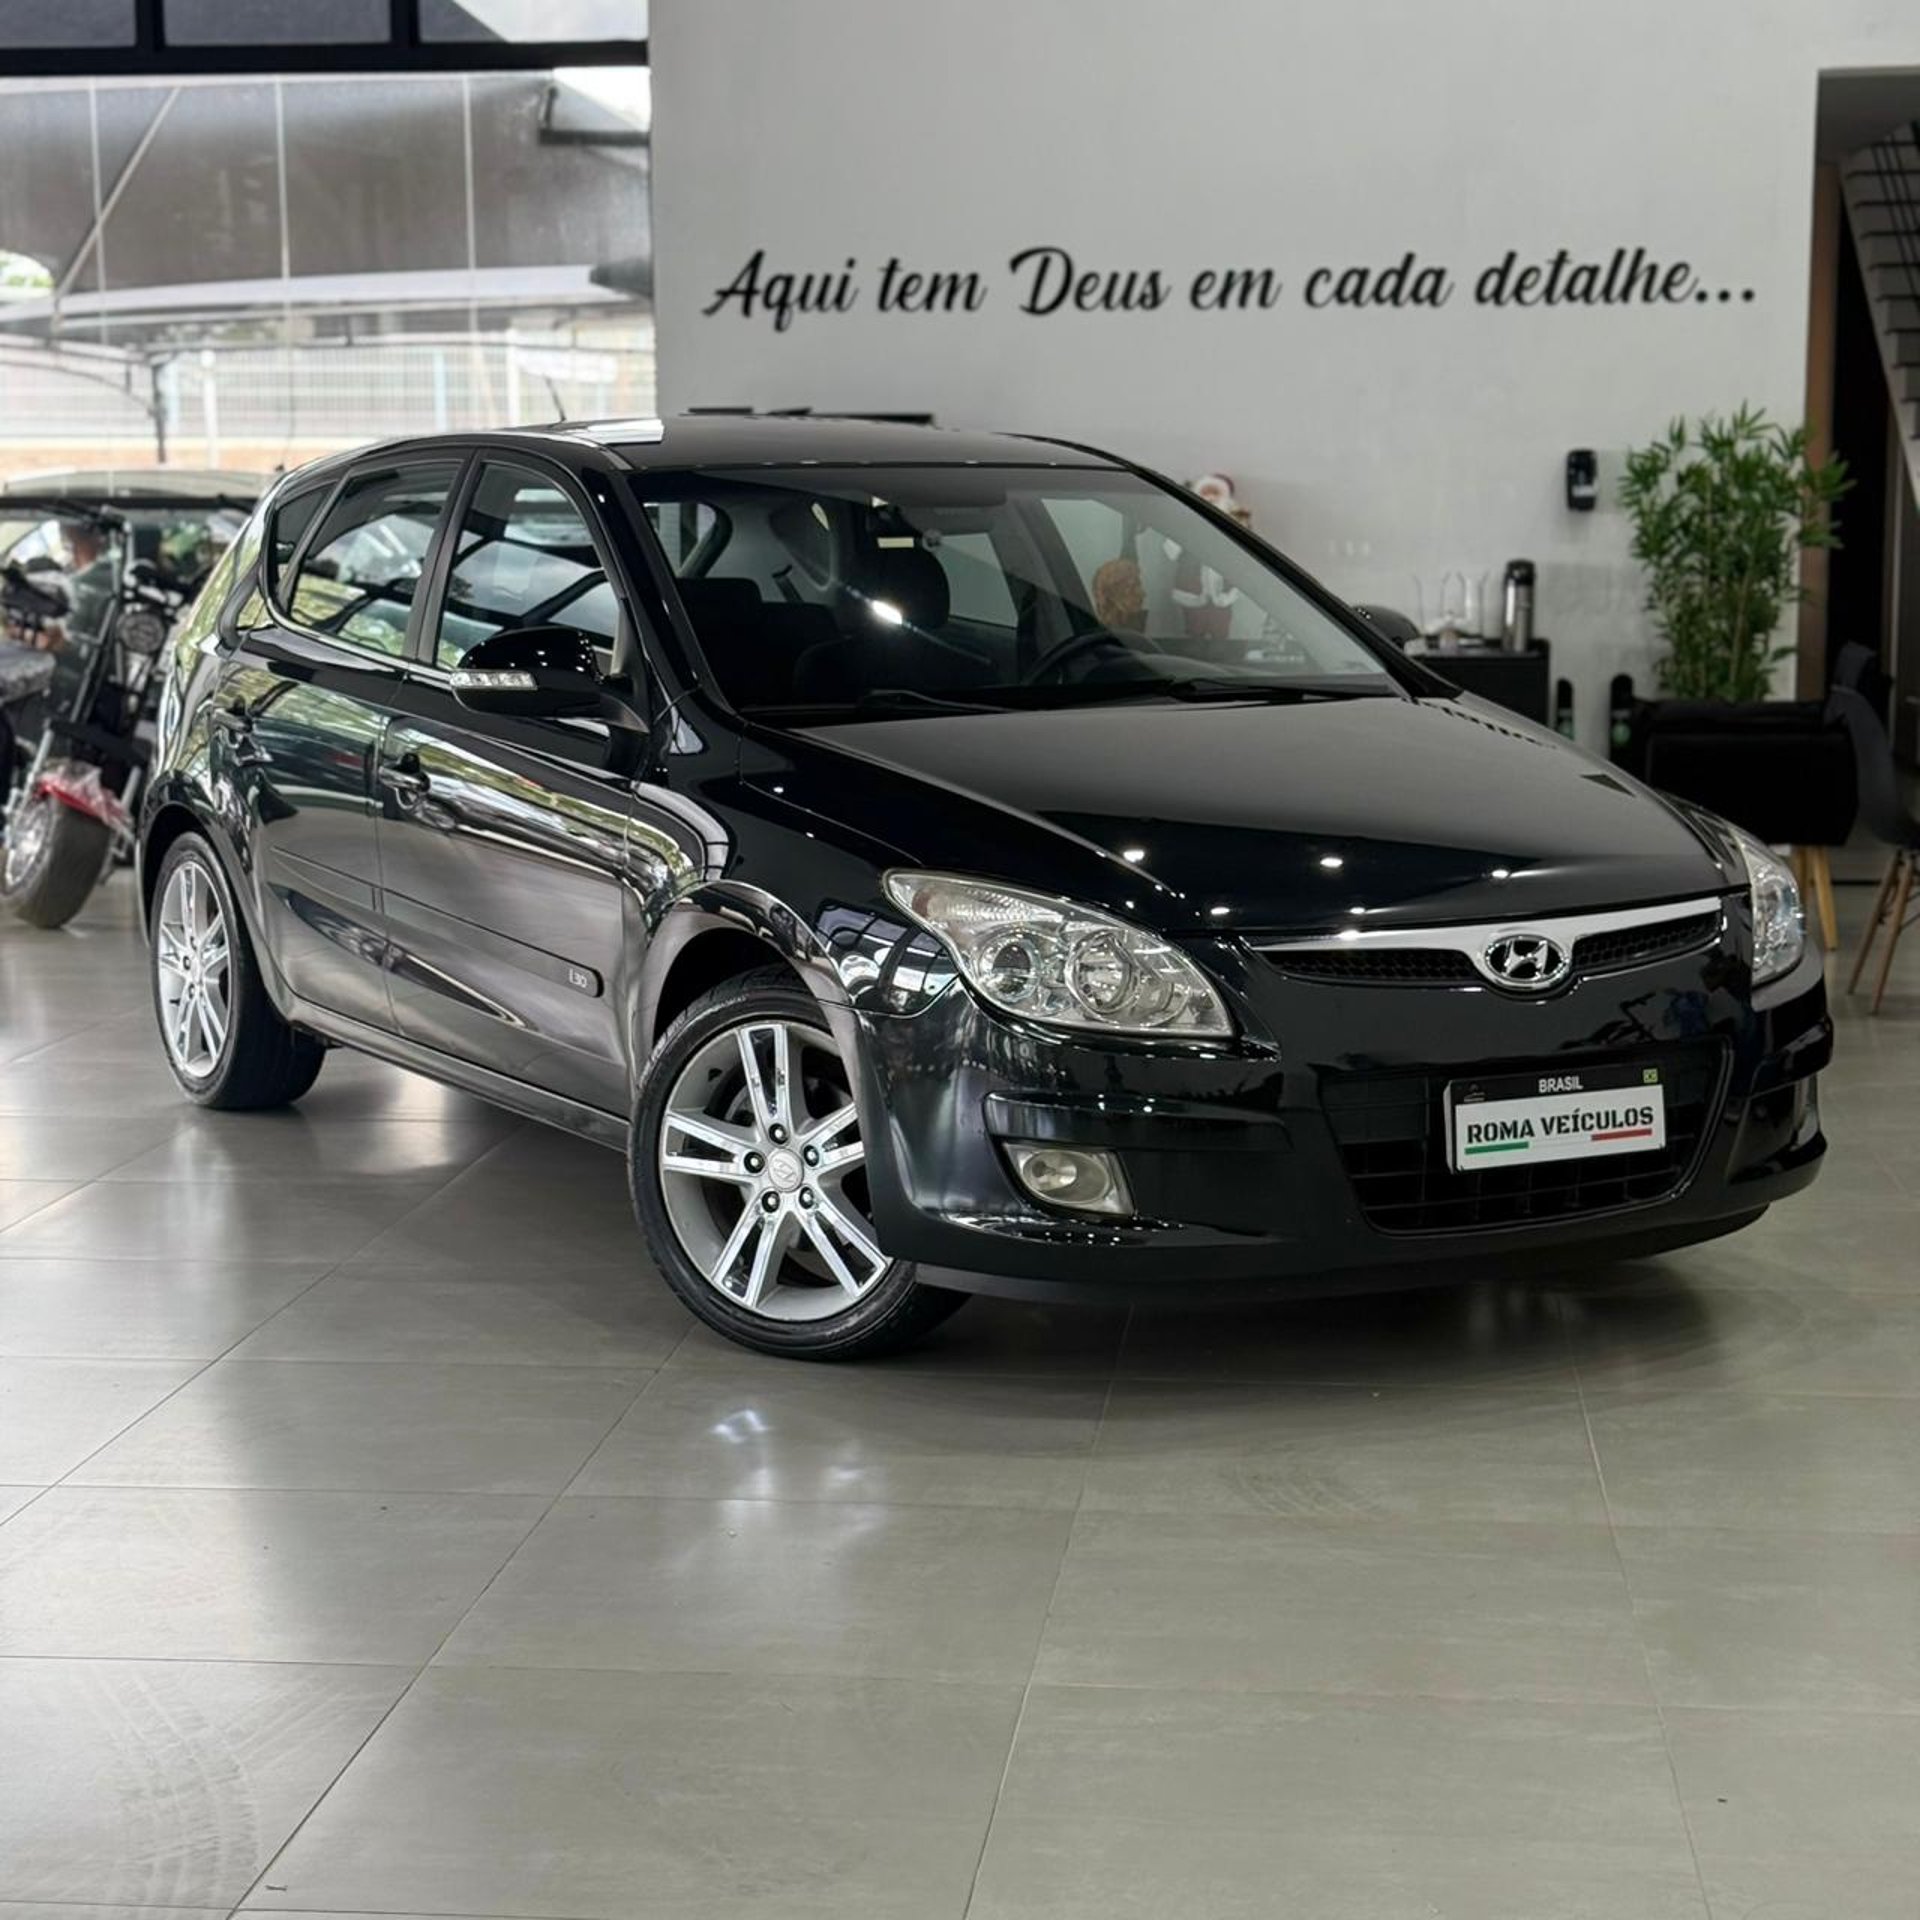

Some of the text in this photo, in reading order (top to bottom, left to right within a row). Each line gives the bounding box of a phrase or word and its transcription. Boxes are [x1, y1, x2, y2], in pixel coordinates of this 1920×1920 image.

[702, 247, 1755, 333] Aqui tem Deus em cada detalhe...
[1538, 1076, 1583, 1093] BRASIL
[1467, 1106, 1654, 1144] ROMA VEÍCULOS
